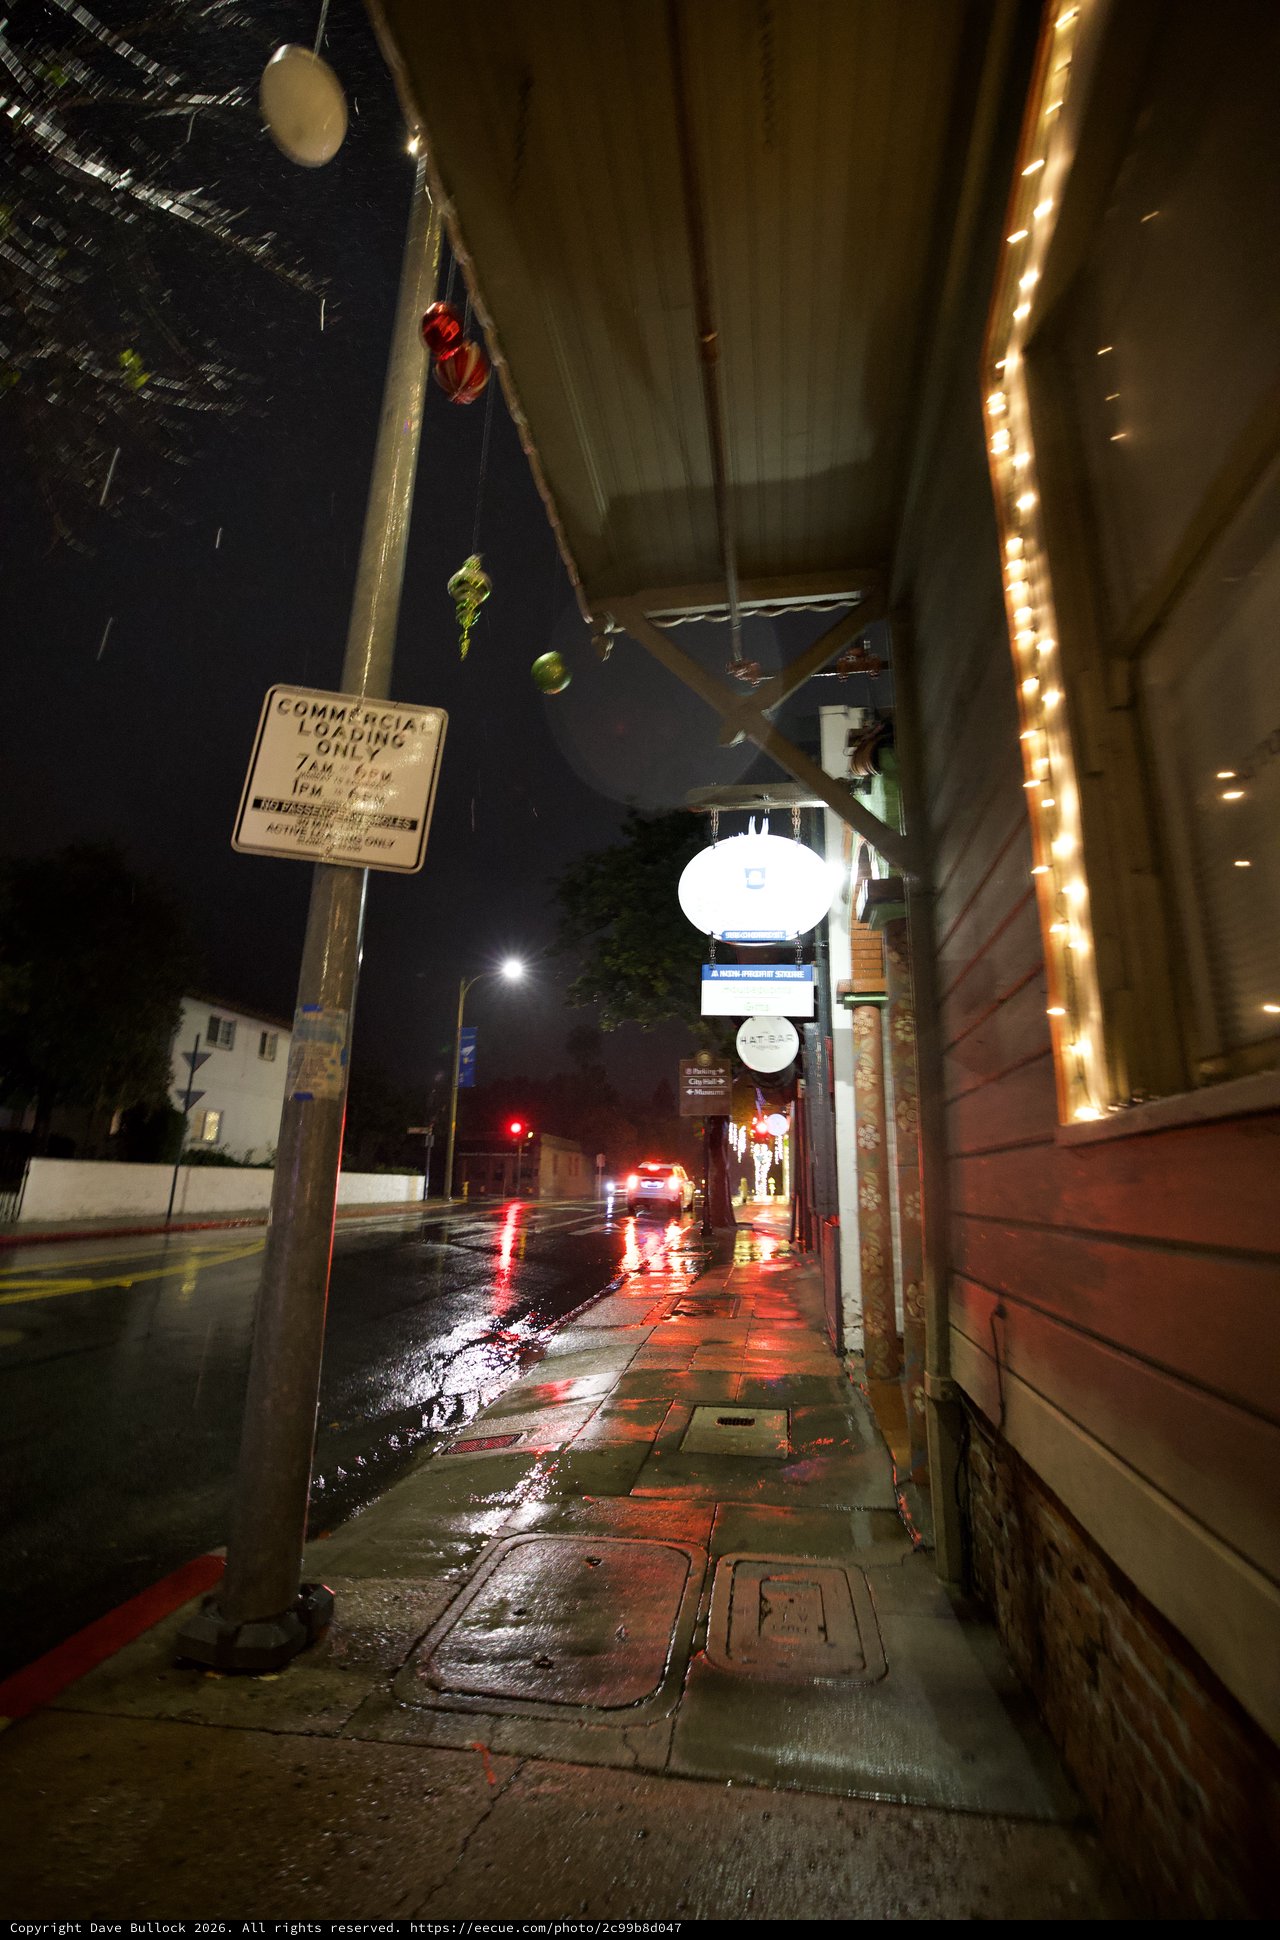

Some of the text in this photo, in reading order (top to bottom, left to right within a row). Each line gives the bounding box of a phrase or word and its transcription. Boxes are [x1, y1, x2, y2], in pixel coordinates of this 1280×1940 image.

[276, 698, 433, 736] COMMERCIAL
[298, 720, 406, 749] LOADING
[316, 739, 380, 763] ONLY
[260, 800, 278, 811] NO
[266, 822, 307, 837] ACTIVE
[364, 837, 396, 849] ONLY
